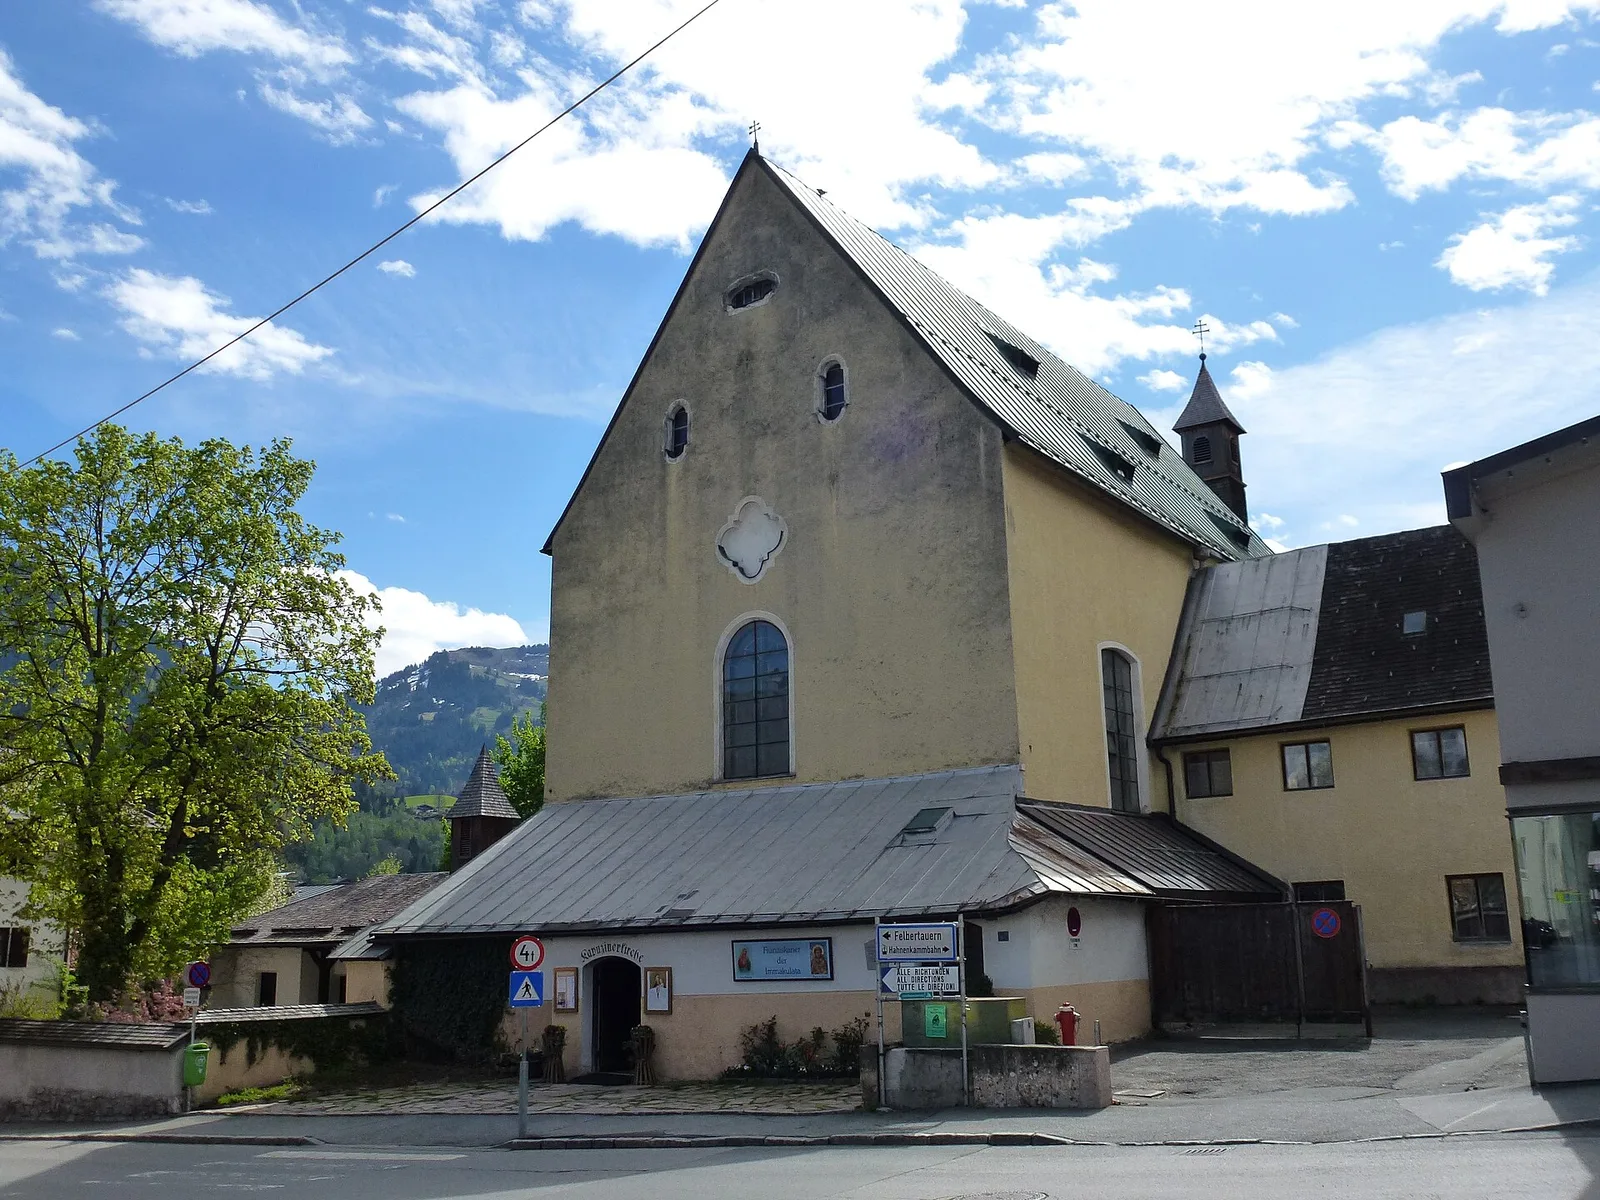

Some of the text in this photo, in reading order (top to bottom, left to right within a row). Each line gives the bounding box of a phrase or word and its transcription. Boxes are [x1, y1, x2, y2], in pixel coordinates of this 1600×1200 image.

[894, 930, 942, 941] Felbertauern
[888, 945, 942, 954] Hahnenkammbahn
[776, 956, 788, 965] der
[765, 967, 802, 976] Immakulata
[896, 968, 950, 976] ALLE RICHTUNGEN
[896, 975, 945, 984] ALL DIRECTIONS
[896, 983, 956, 991] TUTTE LE DIREZIONI
